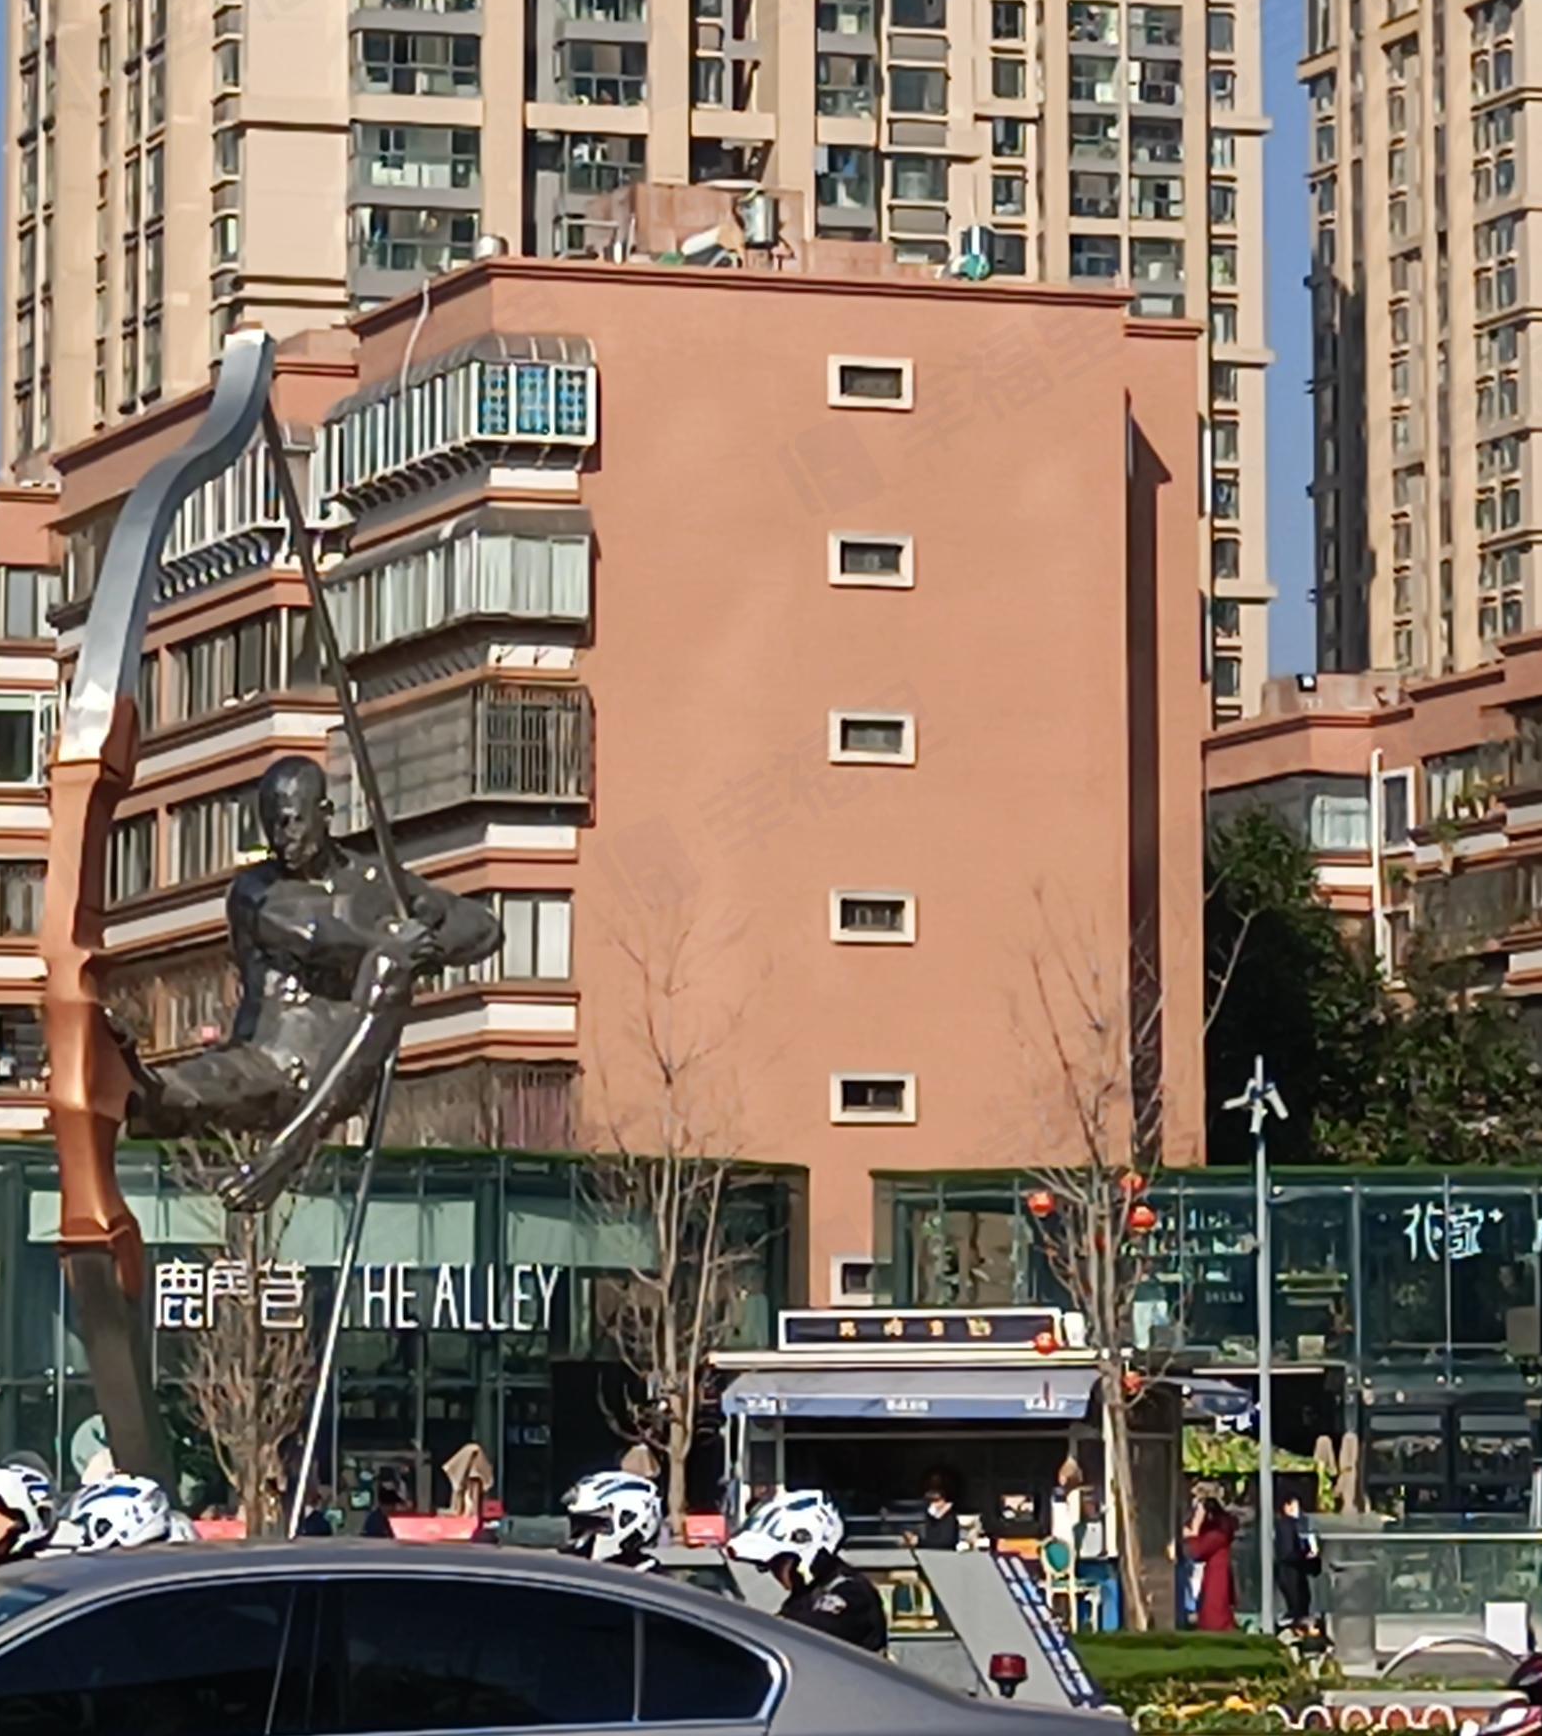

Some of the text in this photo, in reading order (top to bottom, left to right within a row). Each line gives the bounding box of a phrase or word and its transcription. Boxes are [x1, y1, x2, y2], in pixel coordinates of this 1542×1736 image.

[155, 1258, 307, 1329] 鹿角巷
[433, 1262, 564, 1331] ALLEY
